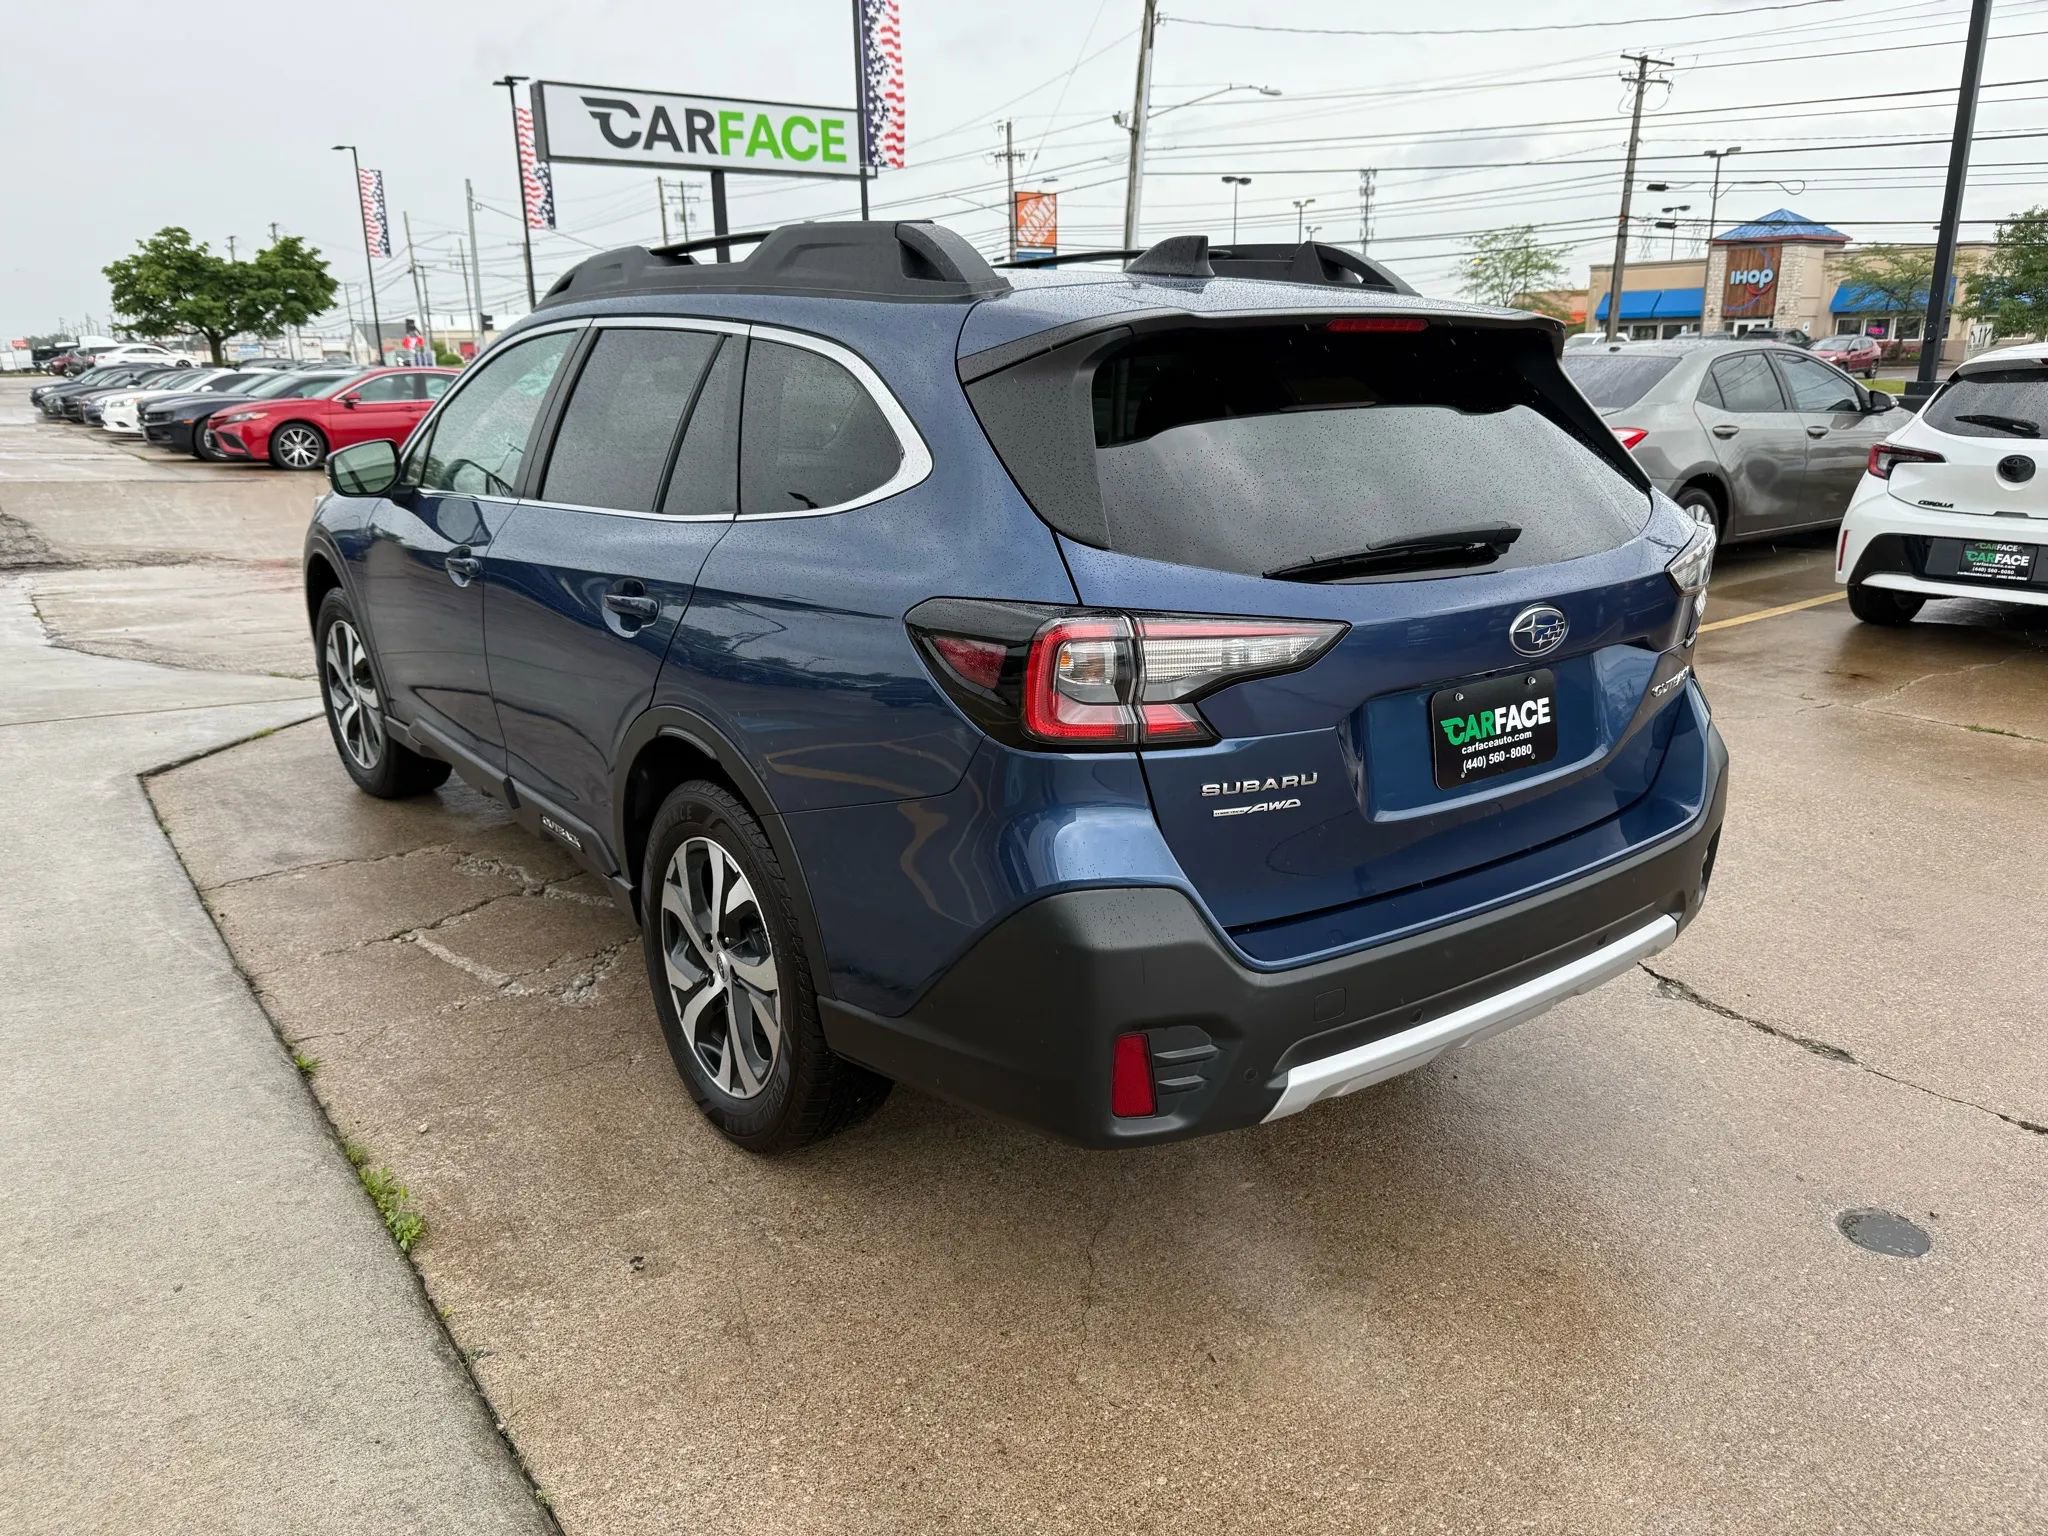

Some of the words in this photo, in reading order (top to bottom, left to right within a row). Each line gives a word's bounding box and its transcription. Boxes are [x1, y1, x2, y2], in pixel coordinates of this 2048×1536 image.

[580, 96, 848, 163] CARFACE
[1017, 193, 1056, 242] HOME
[1965, 550, 2030, 566] CARFACE
[1440, 697, 1551, 746] CARFACE
[1461, 731, 1532, 754] carfaceauto.com
[1463, 755, 1487, 773] (440)
[1201, 772, 1318, 797] SUBARU
[1247, 798, 1301, 814] AWD
